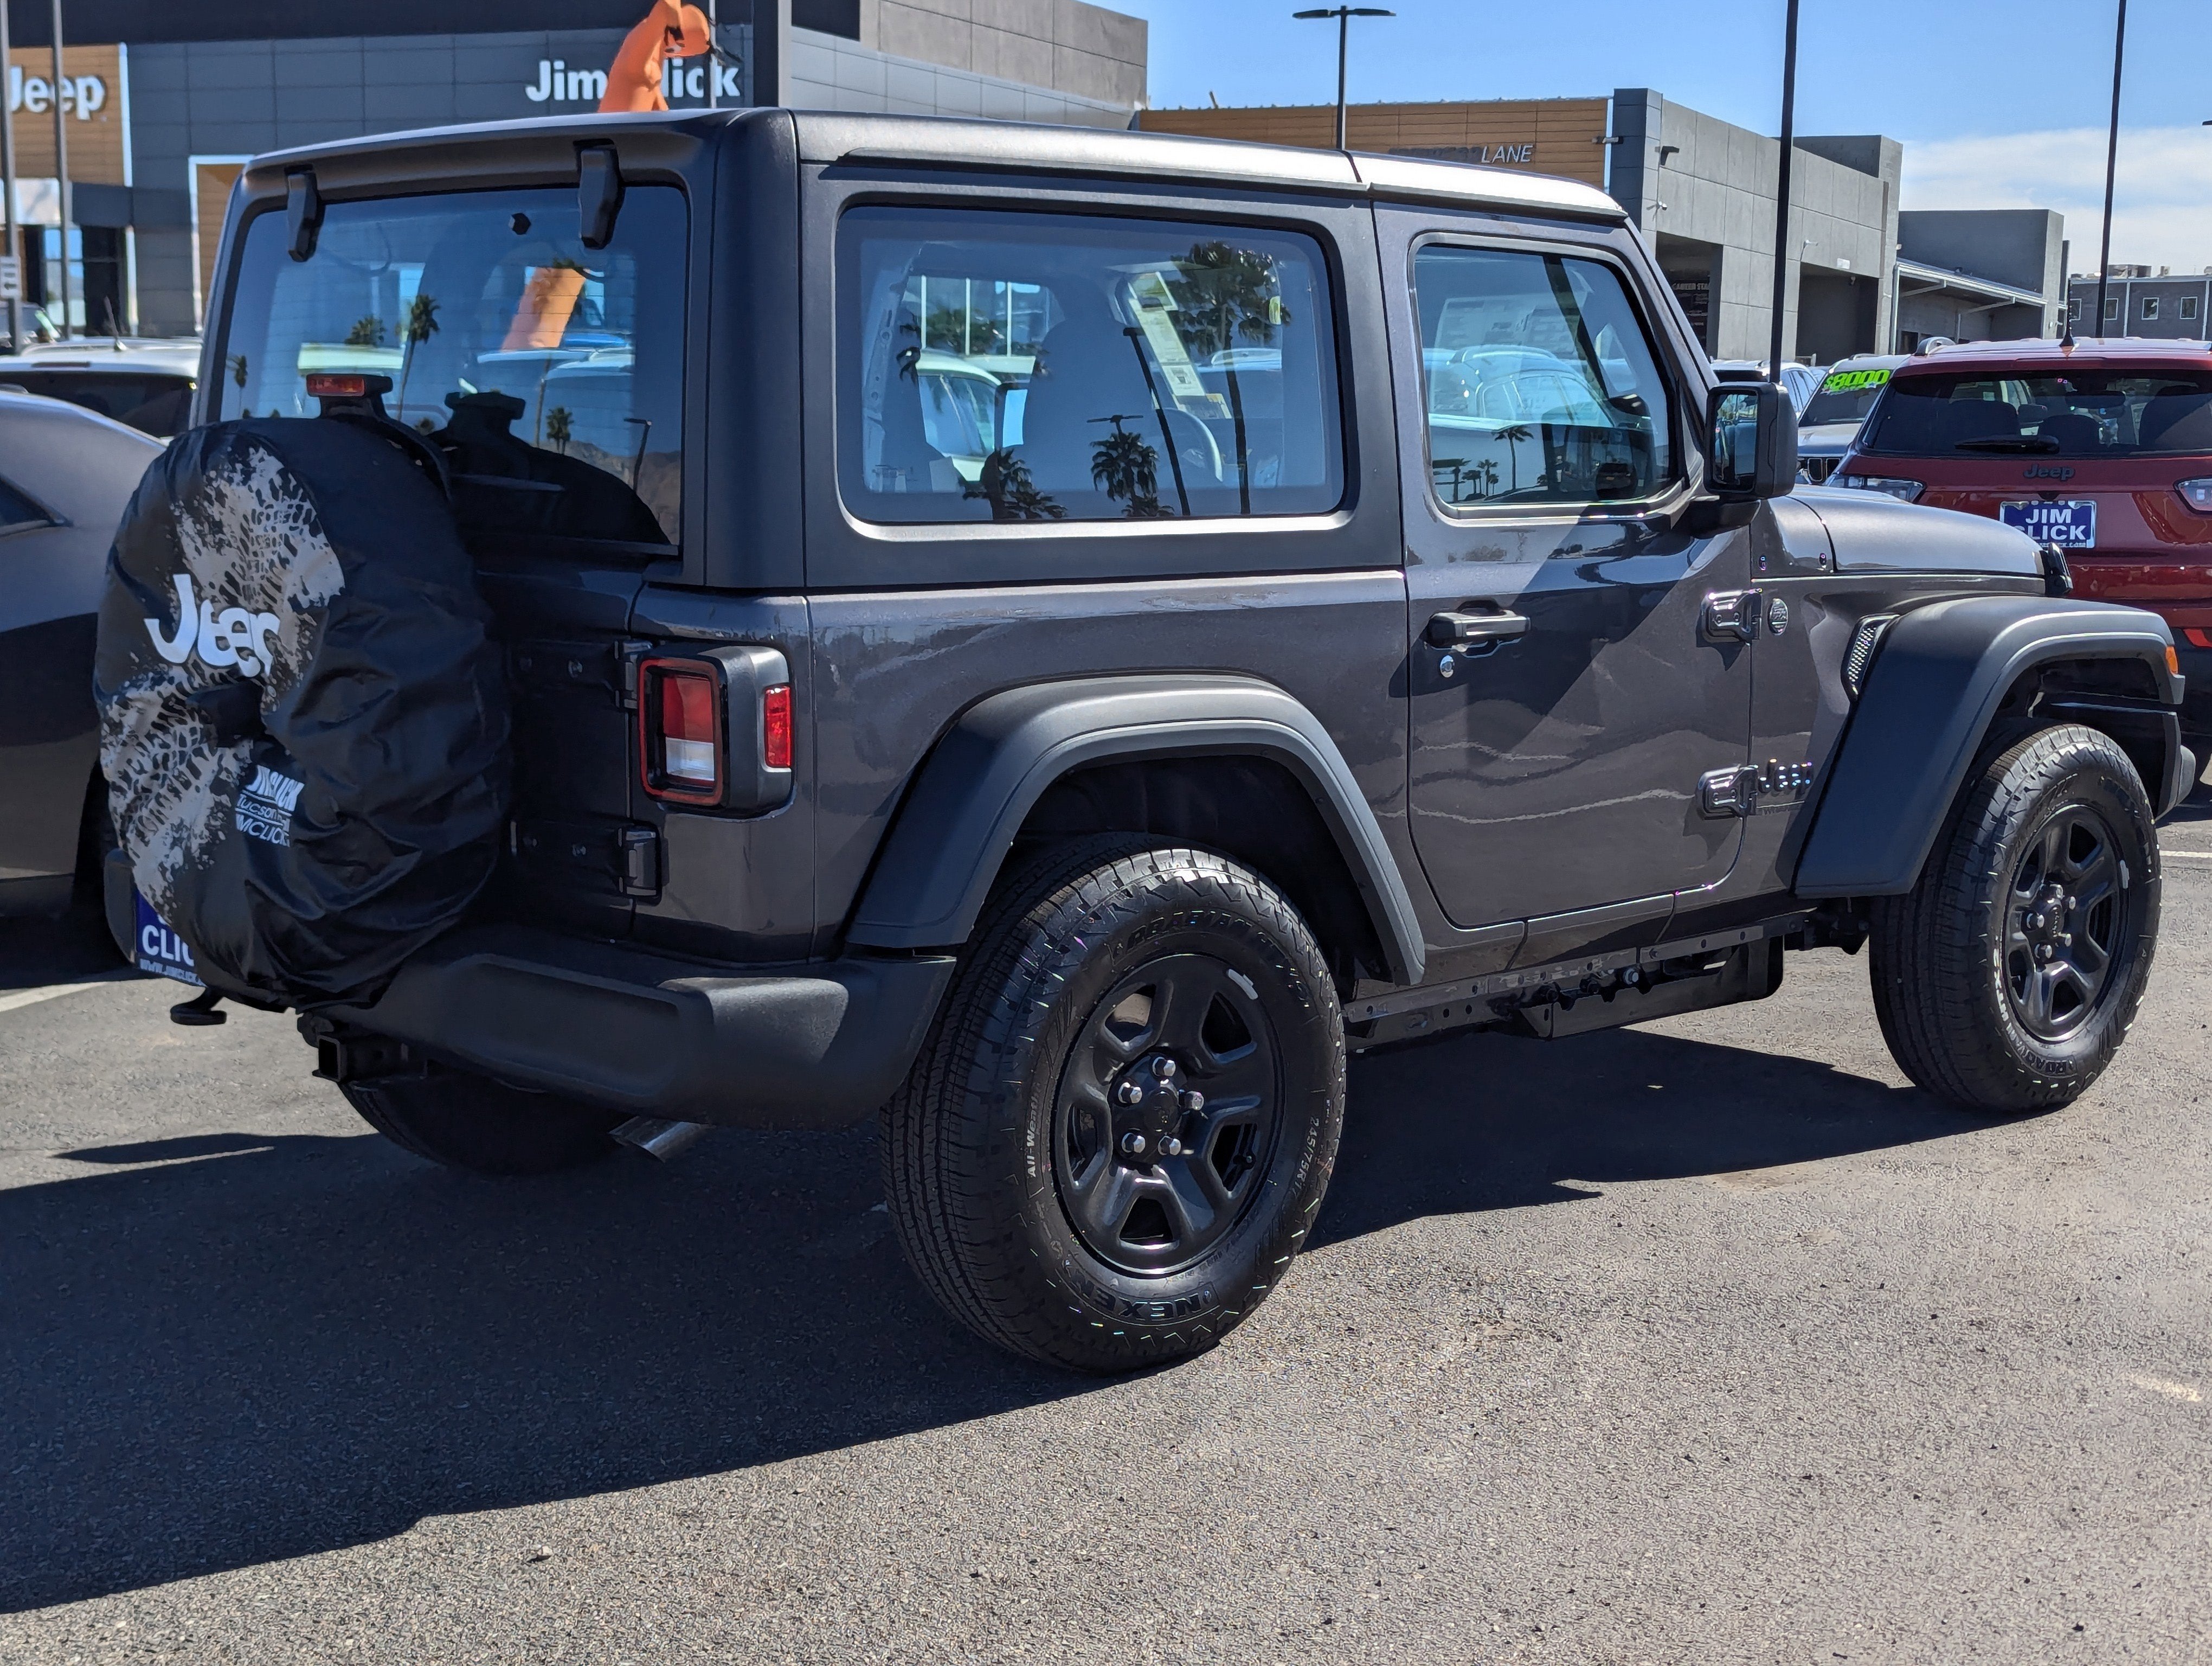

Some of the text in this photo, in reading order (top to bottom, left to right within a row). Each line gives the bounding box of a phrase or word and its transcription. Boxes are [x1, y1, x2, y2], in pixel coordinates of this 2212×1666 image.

[525, 57, 741, 101] Jim lick
[10, 66, 105, 120] Jeep
[1481, 144, 1533, 163] LANE
[1823, 369, 1890, 391] $8000
[2023, 464, 2075, 482] Jeep
[2025, 509, 2072, 524] JIM
